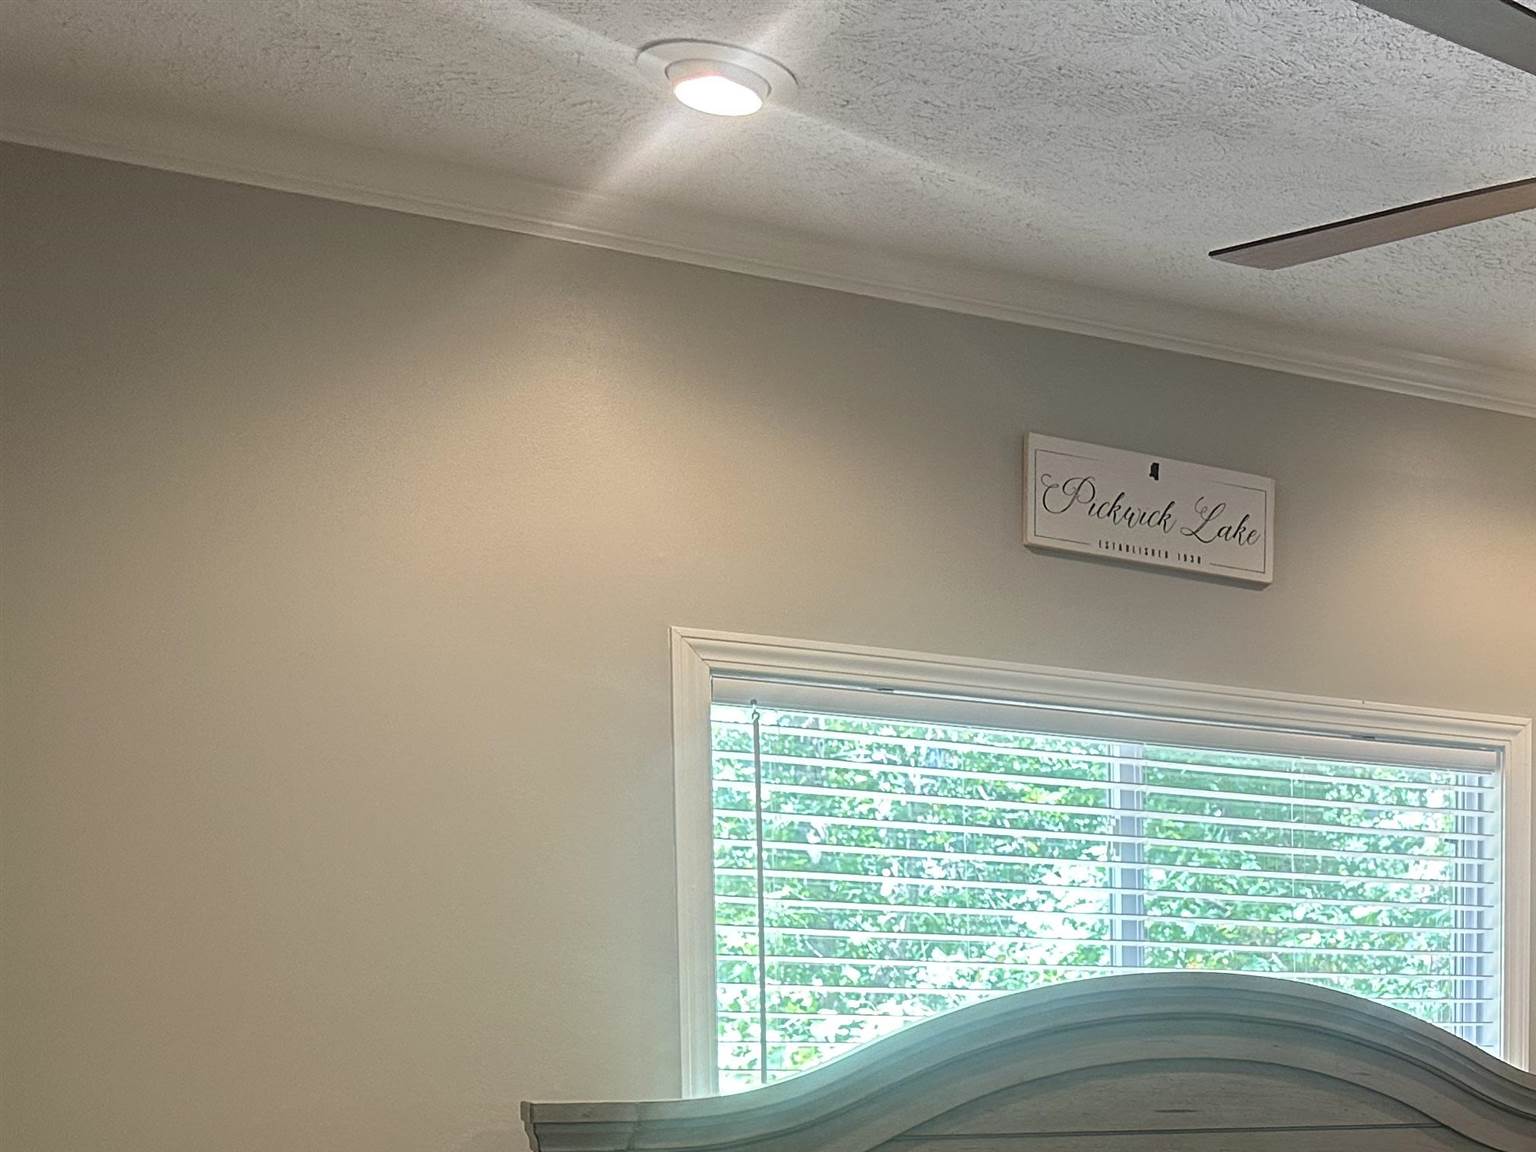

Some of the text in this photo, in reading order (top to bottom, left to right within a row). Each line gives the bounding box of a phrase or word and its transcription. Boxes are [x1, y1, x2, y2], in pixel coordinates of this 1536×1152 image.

[1040, 473, 1261, 547] Pickwick Lake
[1098, 539, 1169, 559] ESTABLISHED
